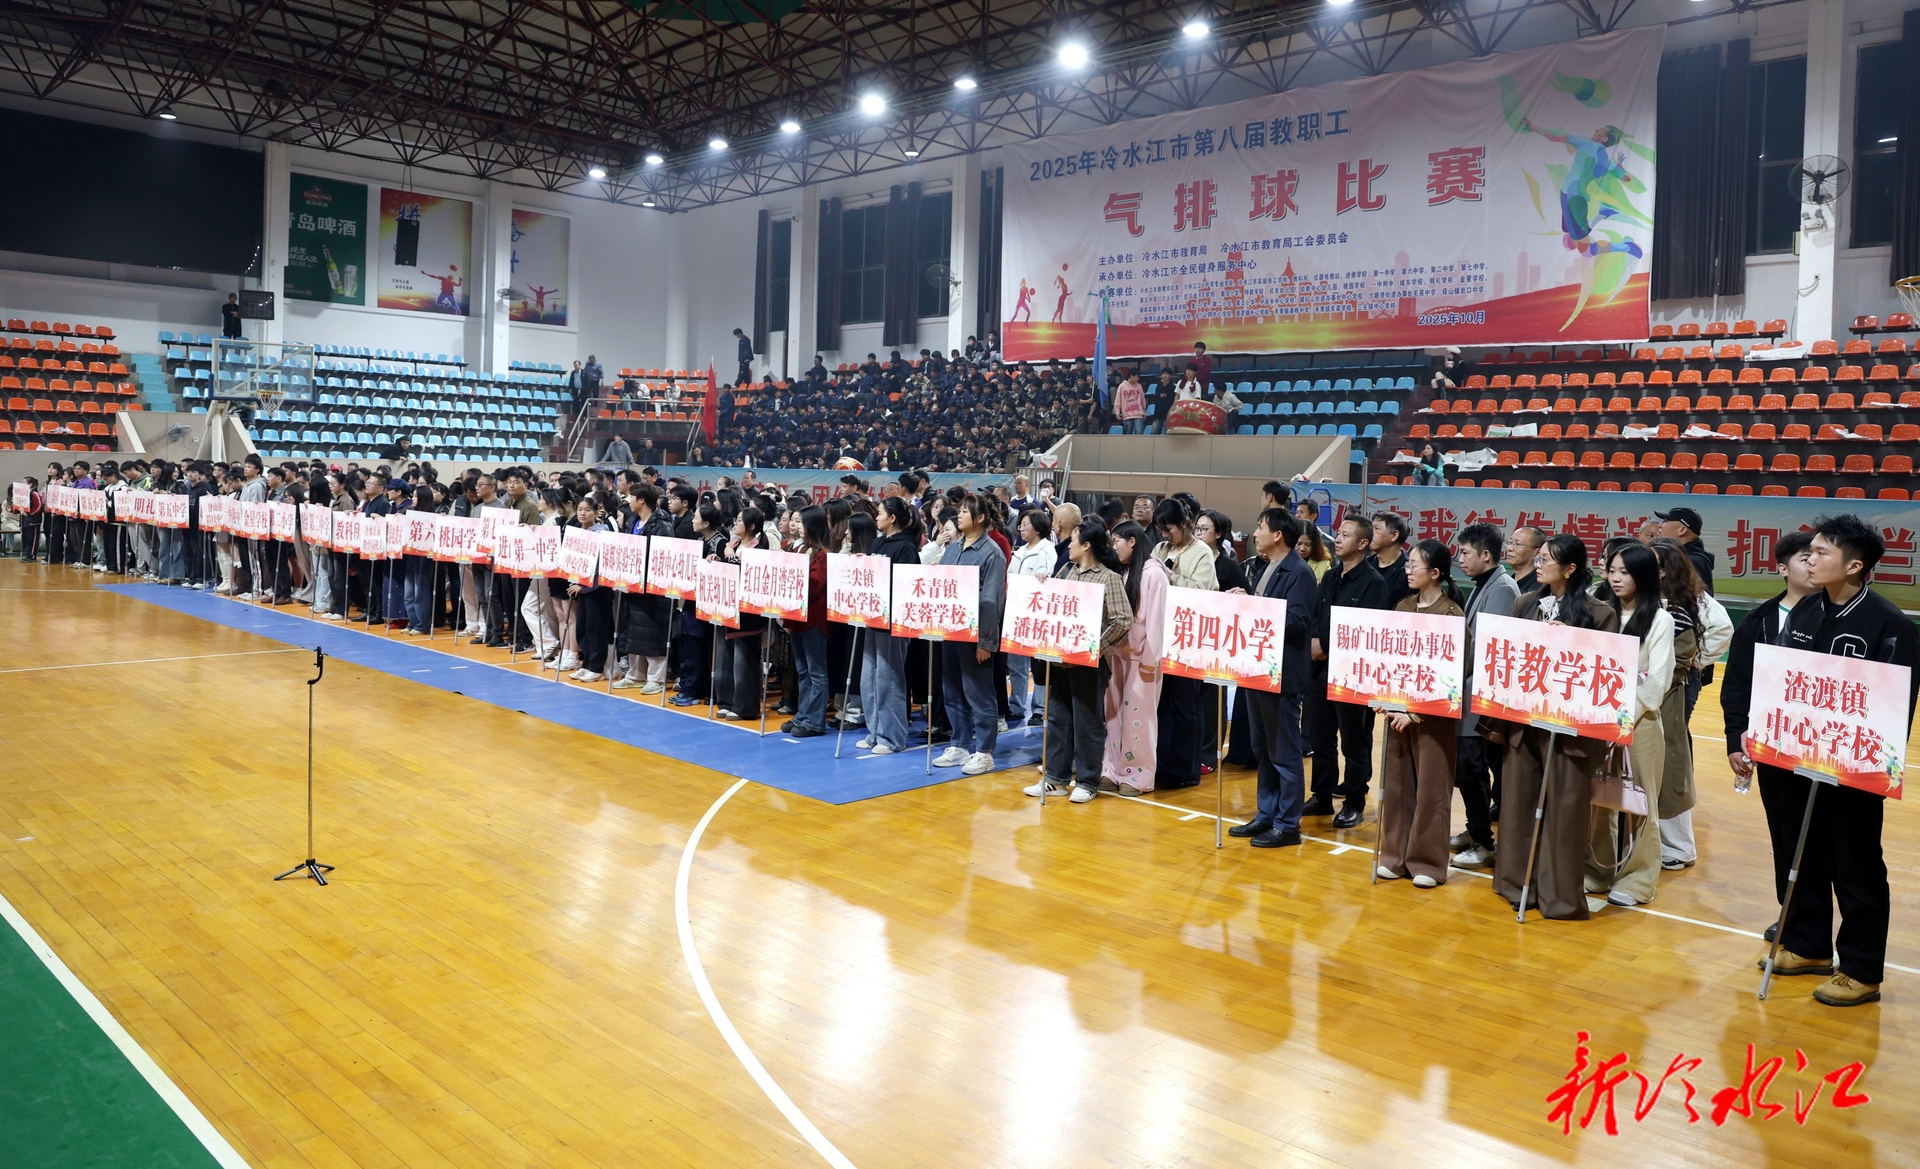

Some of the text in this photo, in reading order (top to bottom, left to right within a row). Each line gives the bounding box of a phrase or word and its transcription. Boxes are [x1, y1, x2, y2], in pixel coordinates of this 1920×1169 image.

[1029, 109, 1351, 181] 2025年冷水江市第八届教职工
[1103, 145, 1485, 237] 气排球比赛
[1220, 231, 1349, 253] 冷水江市教育局工会委员会
[1417, 310, 1486, 326] 2025年10月
[159, 501, 187, 518] 第五中学
[514, 538, 558, 563] 第一中学
[566, 554, 589, 573] 中心学校
[651, 548, 698, 580] 幼教中心幼儿园
[699, 572, 737, 608] 机关幼儿园
[743, 562, 805, 601] 红日金月湾学校
[840, 568, 875, 588] 三尖镇
[911, 577, 959, 600] 禾青镇
[833, 588, 881, 613] 中心学校
[901, 602, 968, 625] 芙蓉学校
[1026, 590, 1080, 618] 禾青镇
[1013, 615, 1087, 647] 潘桥中学
[1172, 605, 1276, 663] 第四小学
[1335, 622, 1457, 663] 锡矿山街道办事处
[1351, 660, 1437, 694] 中心学校
[1484, 636, 1628, 710] 特教学校
[1783, 669, 1869, 718] 渣渡镇
[1765, 707, 1884, 767] 中心学校
